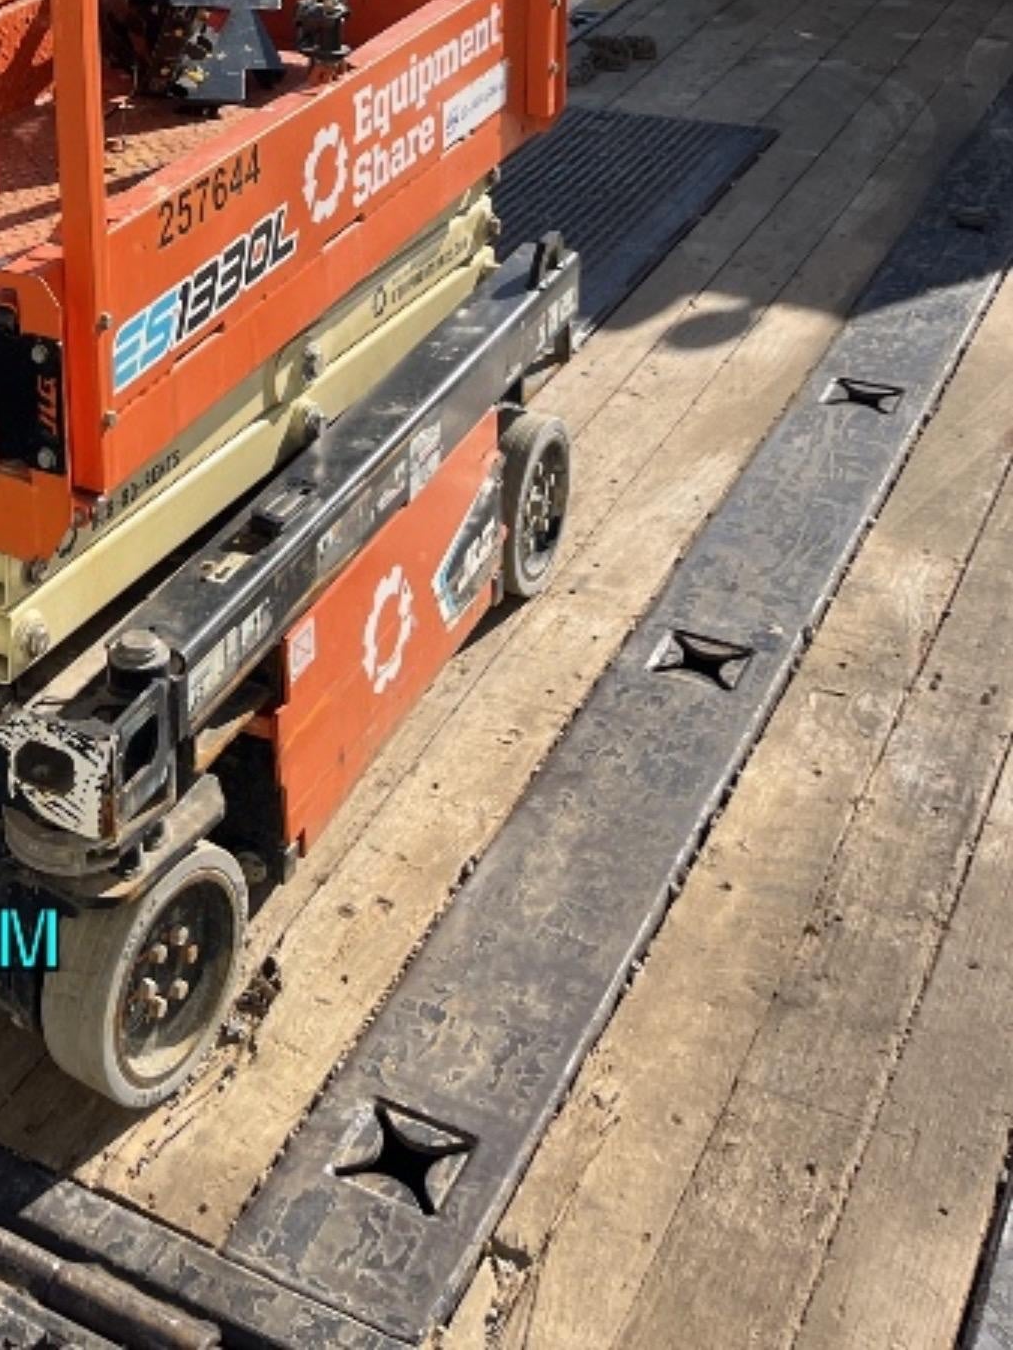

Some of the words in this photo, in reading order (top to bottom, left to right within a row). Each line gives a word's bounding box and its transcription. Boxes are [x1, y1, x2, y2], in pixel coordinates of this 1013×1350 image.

[352, 2, 504, 145] Equipment
[158, 144, 261, 248] 257644
[352, 115, 435, 208] Share
[113, 202, 298, 394] ES1330L
